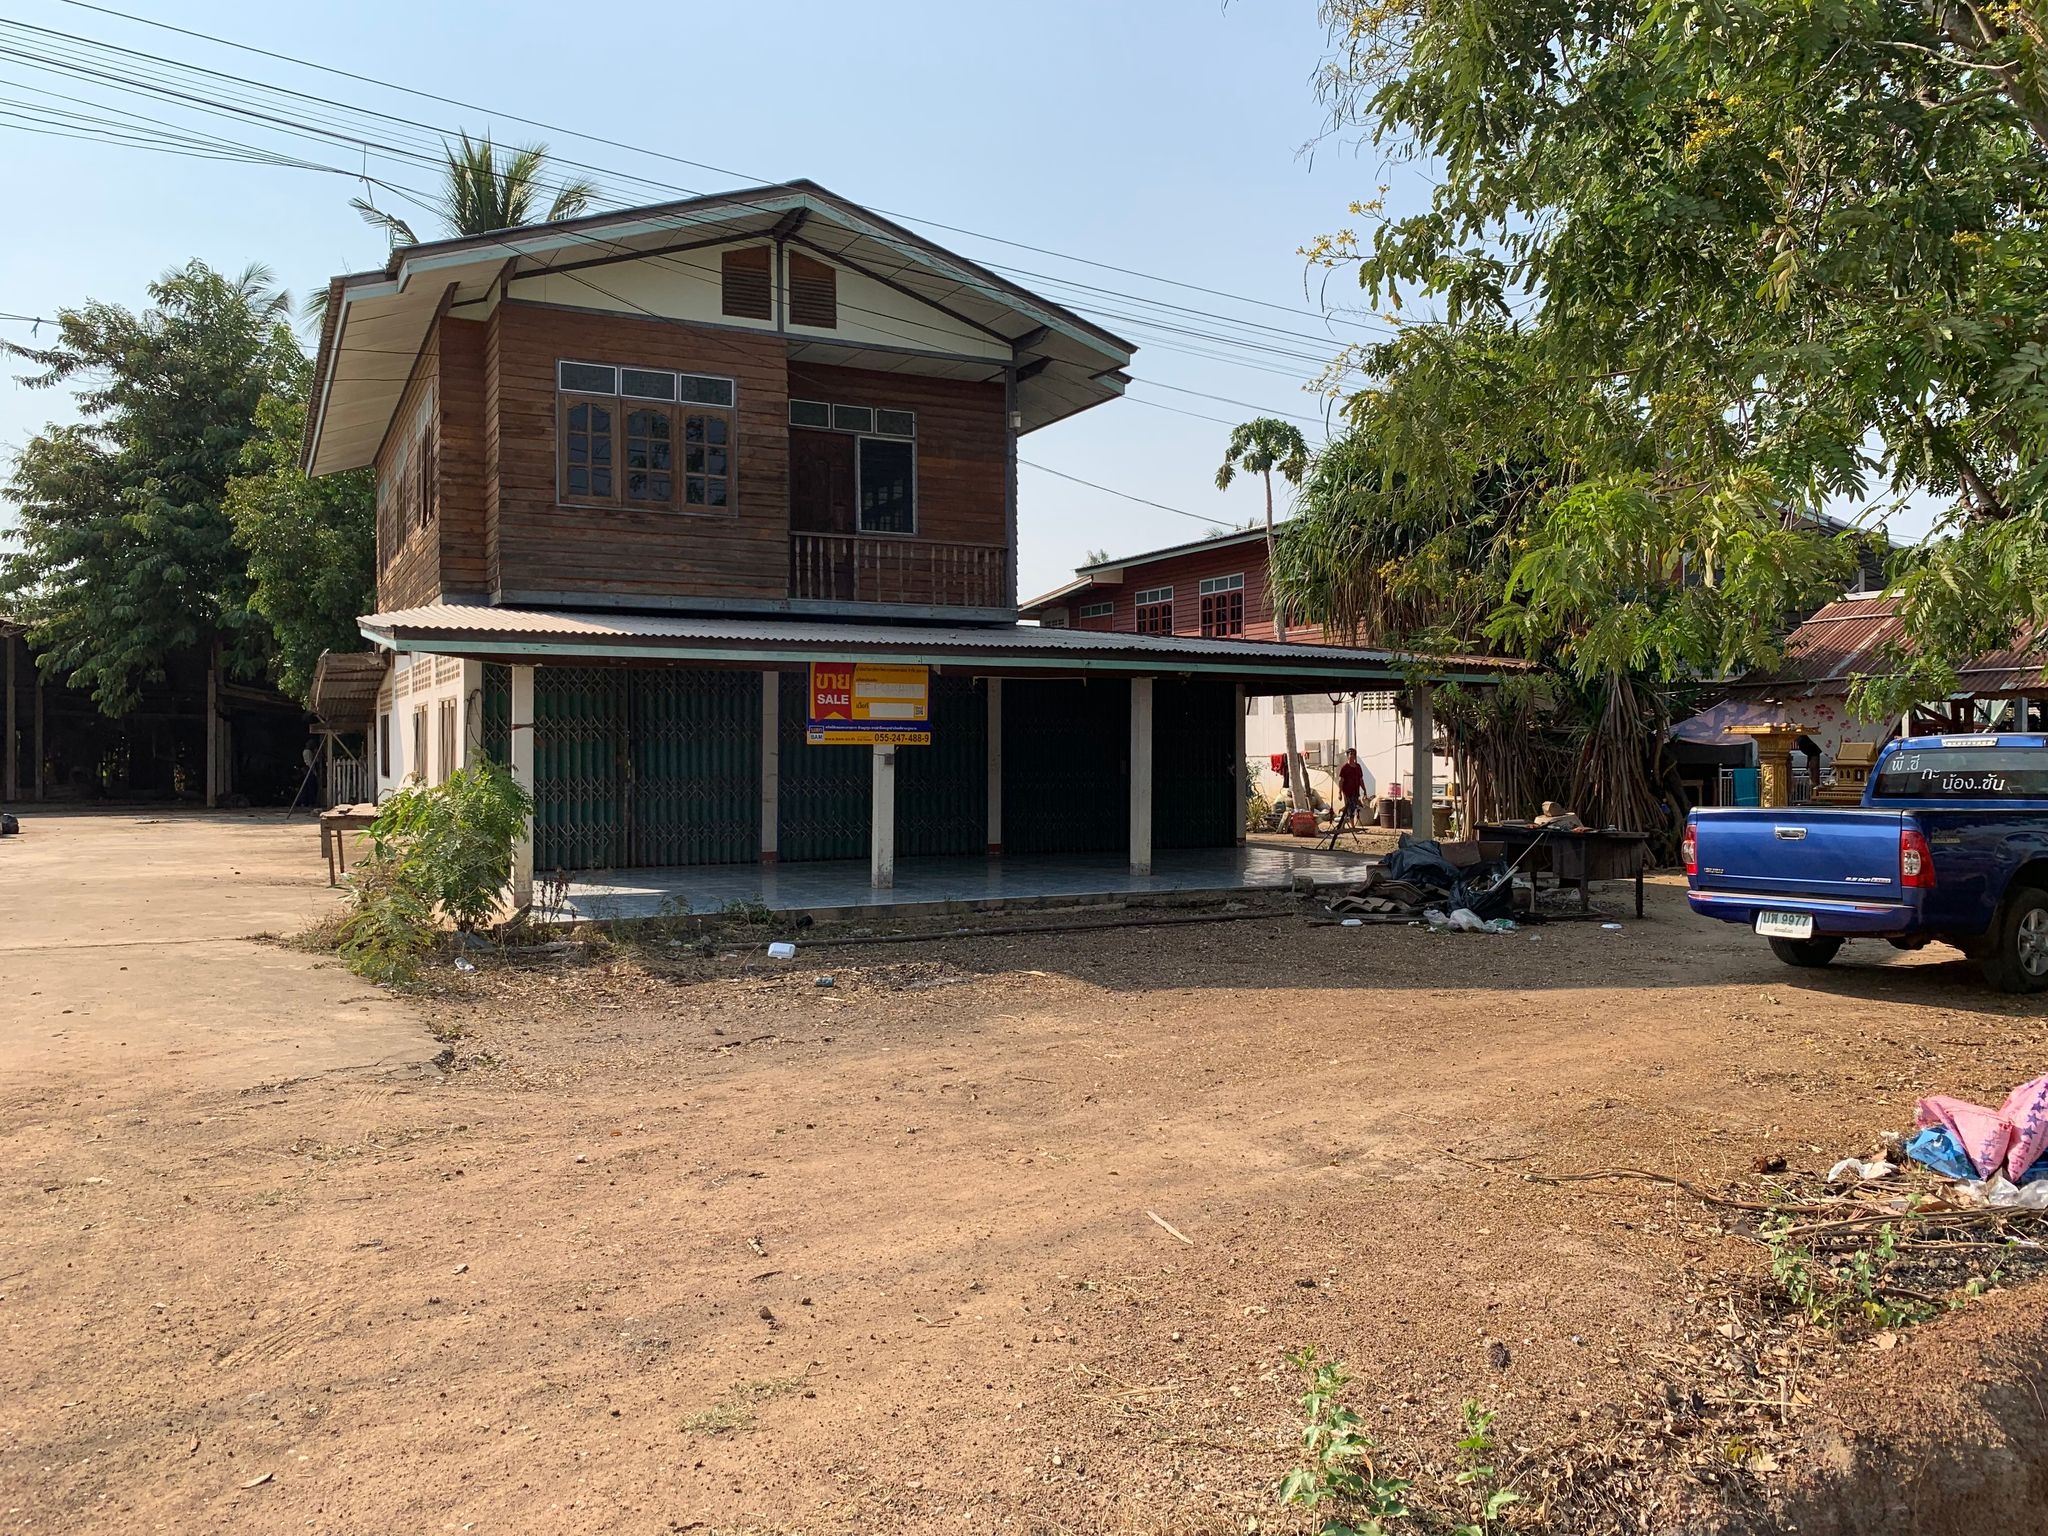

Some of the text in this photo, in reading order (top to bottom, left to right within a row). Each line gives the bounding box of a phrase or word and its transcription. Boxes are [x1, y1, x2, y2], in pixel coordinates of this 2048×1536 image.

[817, 673, 850, 690] ขาย
[817, 694, 849, 705] SALE
[874, 733, 929, 743] 055-247-488-9
[1781, 913, 1809, 927] 9977
